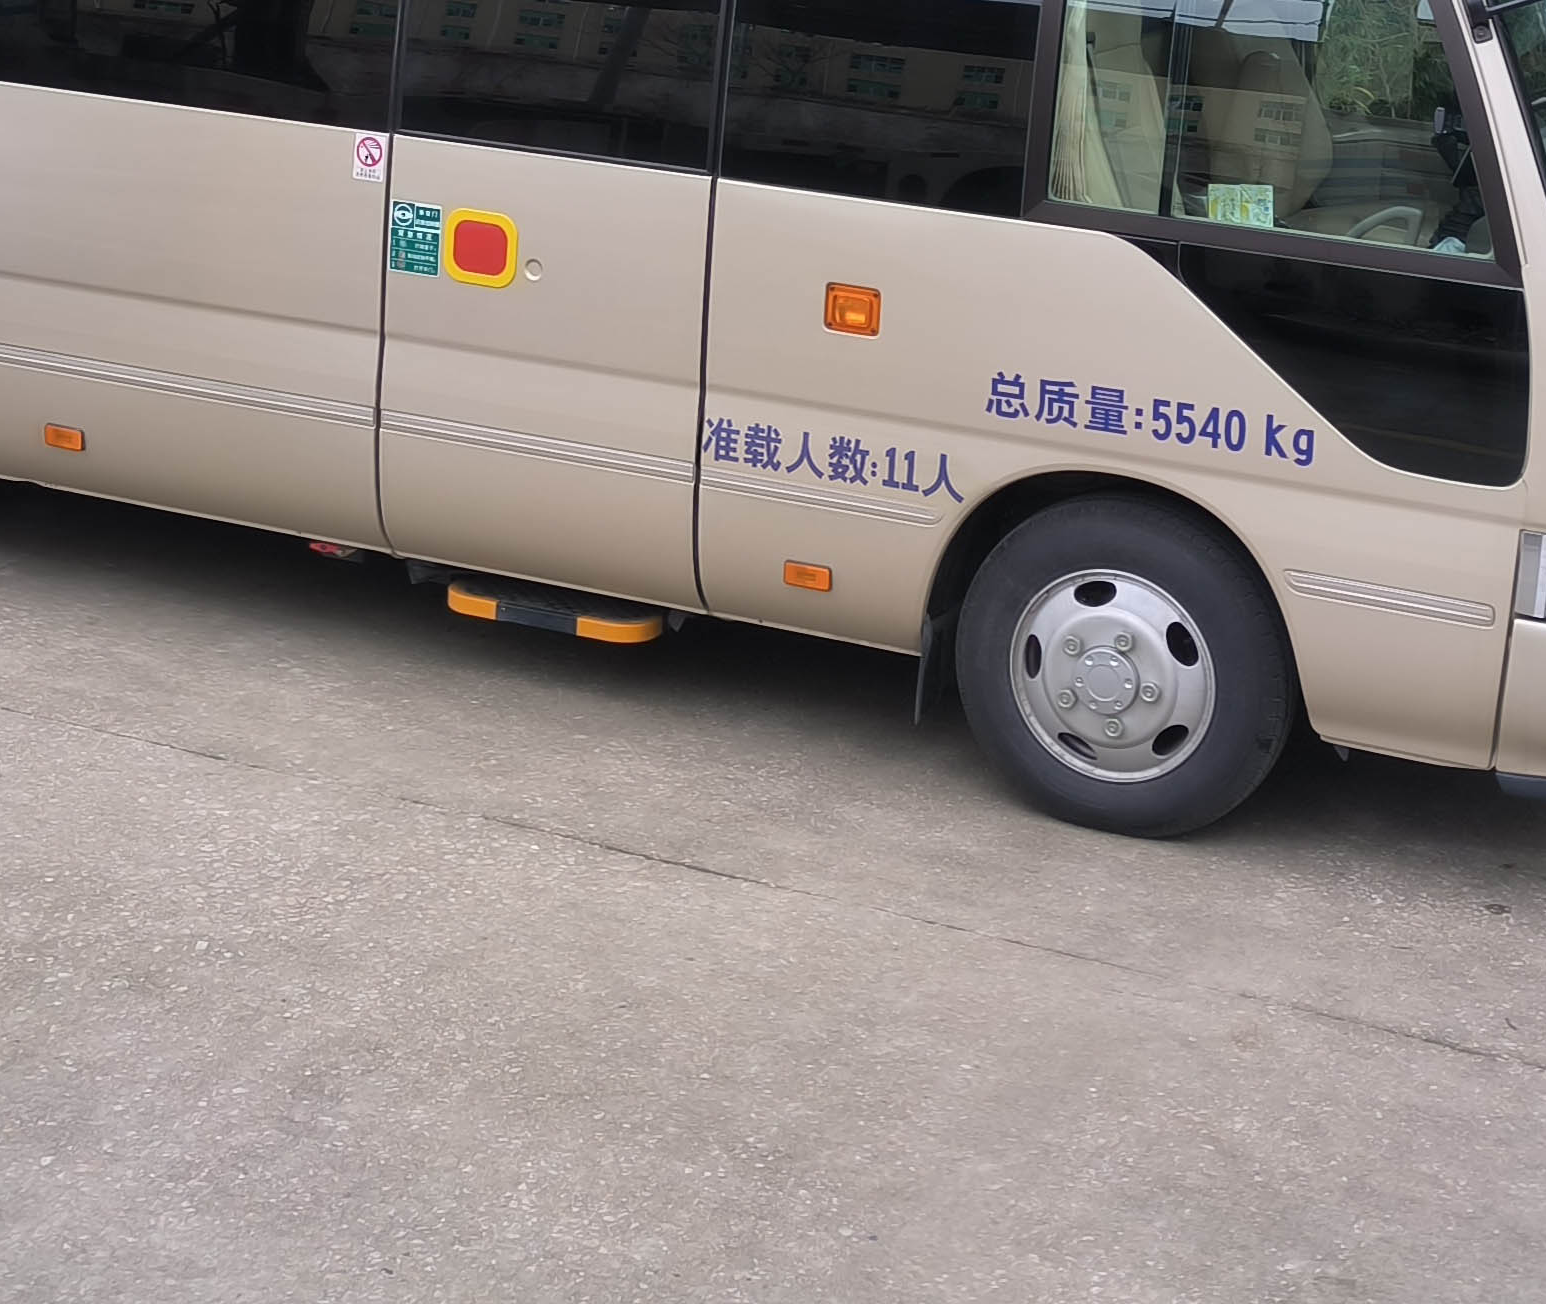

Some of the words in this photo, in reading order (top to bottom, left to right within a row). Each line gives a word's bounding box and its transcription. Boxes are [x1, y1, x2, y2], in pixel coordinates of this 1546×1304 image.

[703, 416, 964, 502] 准载人数:11人
[985, 371, 1247, 453] 总质量:5540
[1264, 414, 1315, 467] kg
